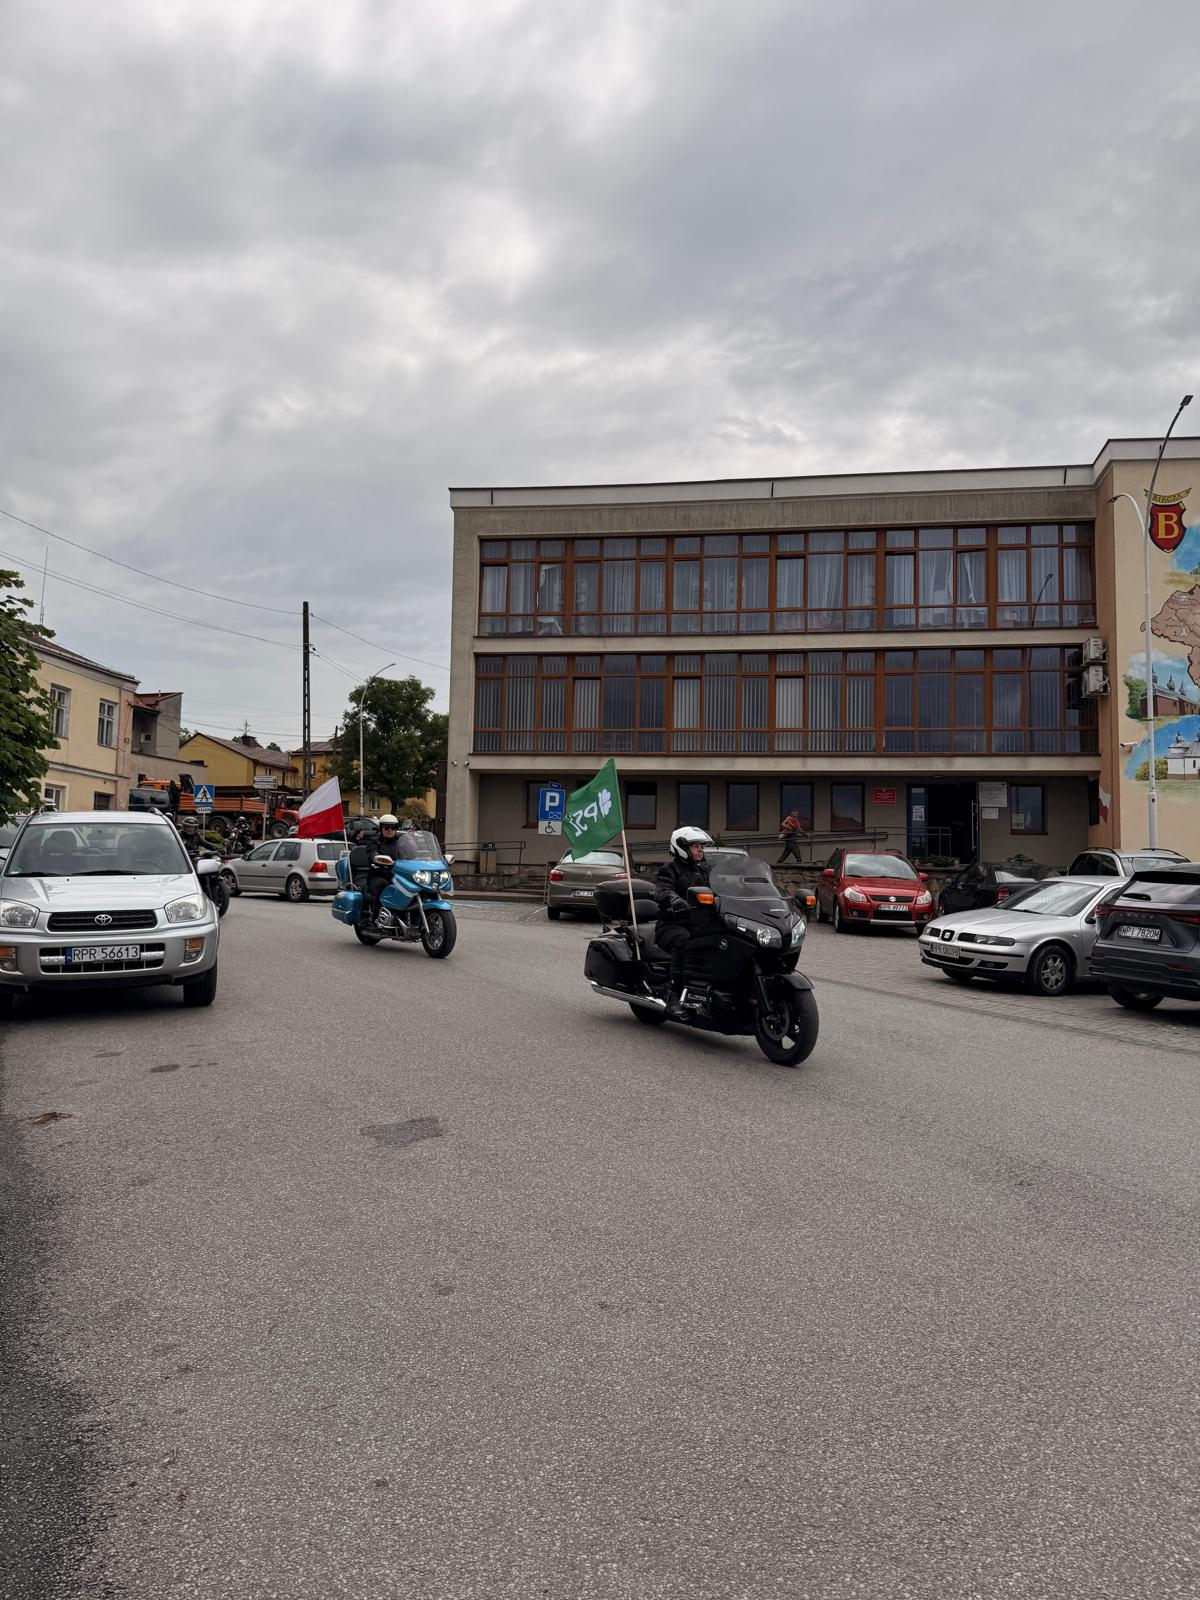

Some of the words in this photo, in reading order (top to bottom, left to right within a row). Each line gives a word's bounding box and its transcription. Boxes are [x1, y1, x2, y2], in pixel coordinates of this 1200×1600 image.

[1157, 512, 1179, 539] B
[545, 791, 560, 812] P
[73, 948, 98, 961] RPR
[101, 946, 139, 960] 56613
